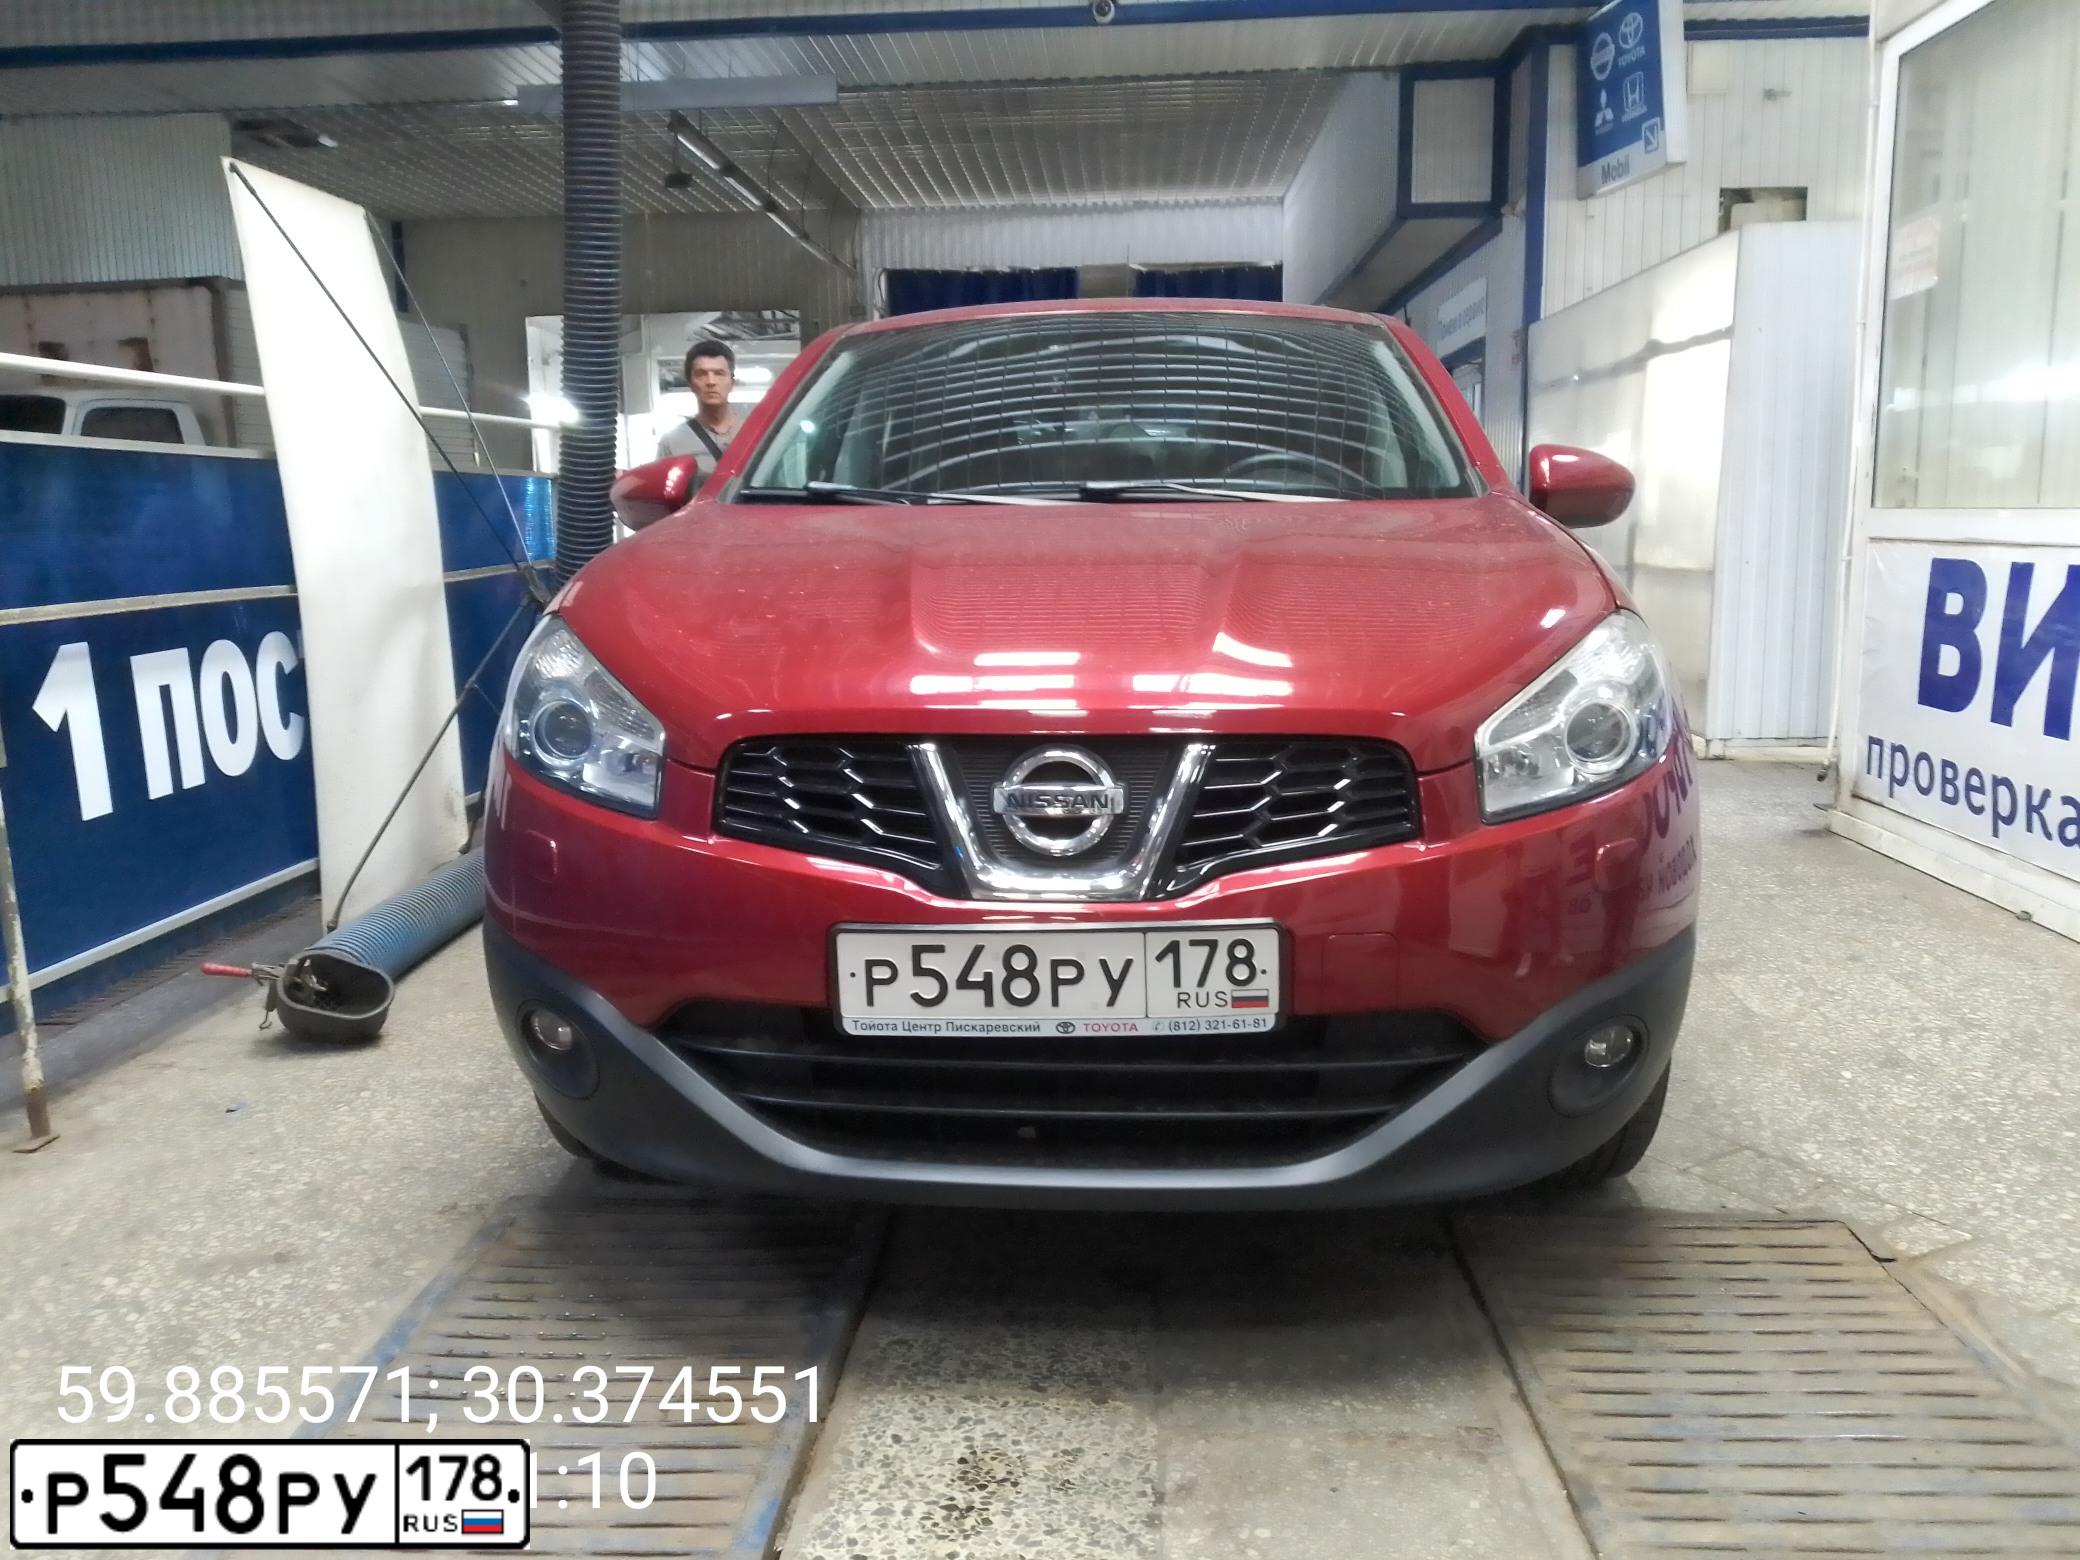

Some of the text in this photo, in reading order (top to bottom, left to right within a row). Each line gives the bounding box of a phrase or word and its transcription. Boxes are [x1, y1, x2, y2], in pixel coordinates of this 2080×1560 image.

[1601, 154, 1631, 185] Mobil
[32, 630, 305, 822] 1 ПОС
[1006, 793, 1109, 809] NISSAN
[1866, 735, 2080, 849] проверка
[1155, 938, 1257, 989] 178
[1177, 991, 1228, 1009] RUS
[852, 1019, 1041, 1034] Тойота Центр Пискаревский
[1083, 1022, 1139, 1034] TOYOTA
[1168, 1017, 1268, 1033] (812) 321-61-81
